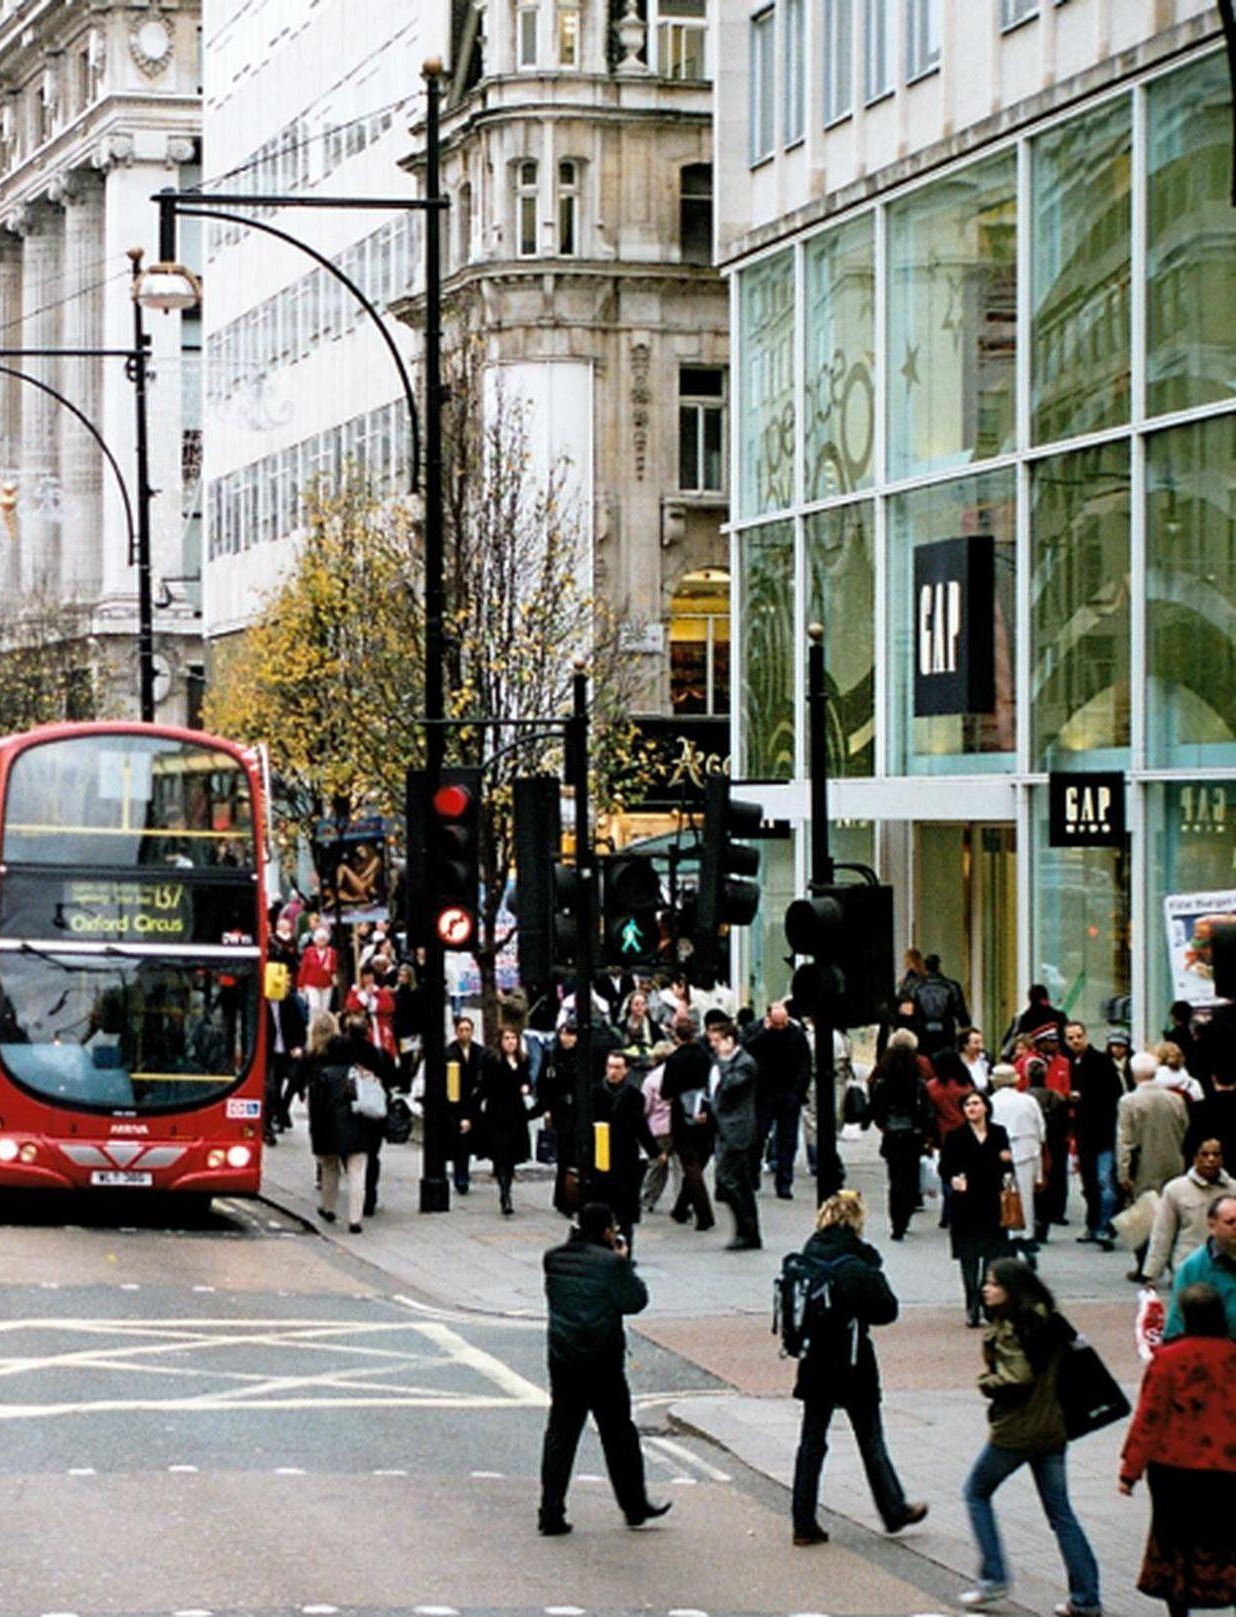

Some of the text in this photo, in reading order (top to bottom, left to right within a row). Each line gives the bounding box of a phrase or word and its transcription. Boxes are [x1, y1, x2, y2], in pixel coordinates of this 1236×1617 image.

[919, 580, 961, 676] GAP
[1065, 786, 1111, 822] GAP
[70, 913, 183, 933] Oxford Circus
